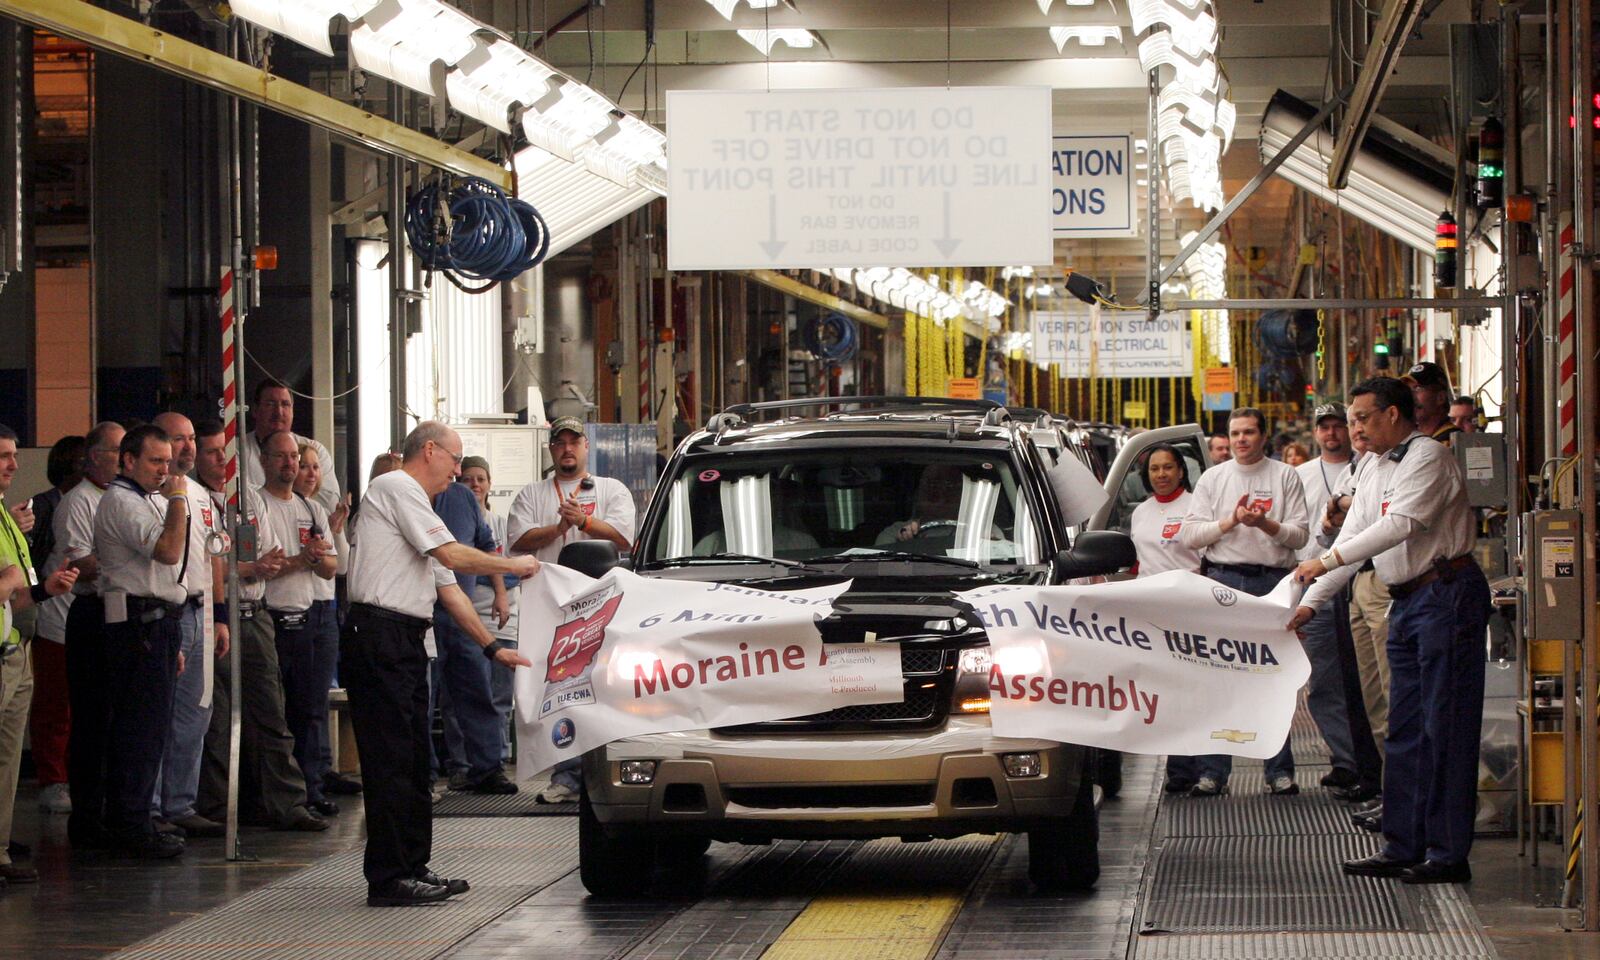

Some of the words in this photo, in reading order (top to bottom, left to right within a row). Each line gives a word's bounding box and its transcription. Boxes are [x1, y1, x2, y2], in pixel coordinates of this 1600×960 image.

[1053, 150, 1122, 176] ATION
[1053, 188, 1105, 215] ONS
[1128, 318, 1179, 332] STATION
[1558, 566, 1571, 575] VC
[639, 613, 664, 628] 6
[1024, 600, 1152, 651] Vehicle
[552, 627, 586, 666] 25
[1164, 629, 1279, 665] IUE-CWA
[634, 642, 806, 699] Moraine
[840, 655, 876, 665] Assembly
[557, 689, 591, 703] IUE-CWA
[989, 664, 1159, 726] Assembly
